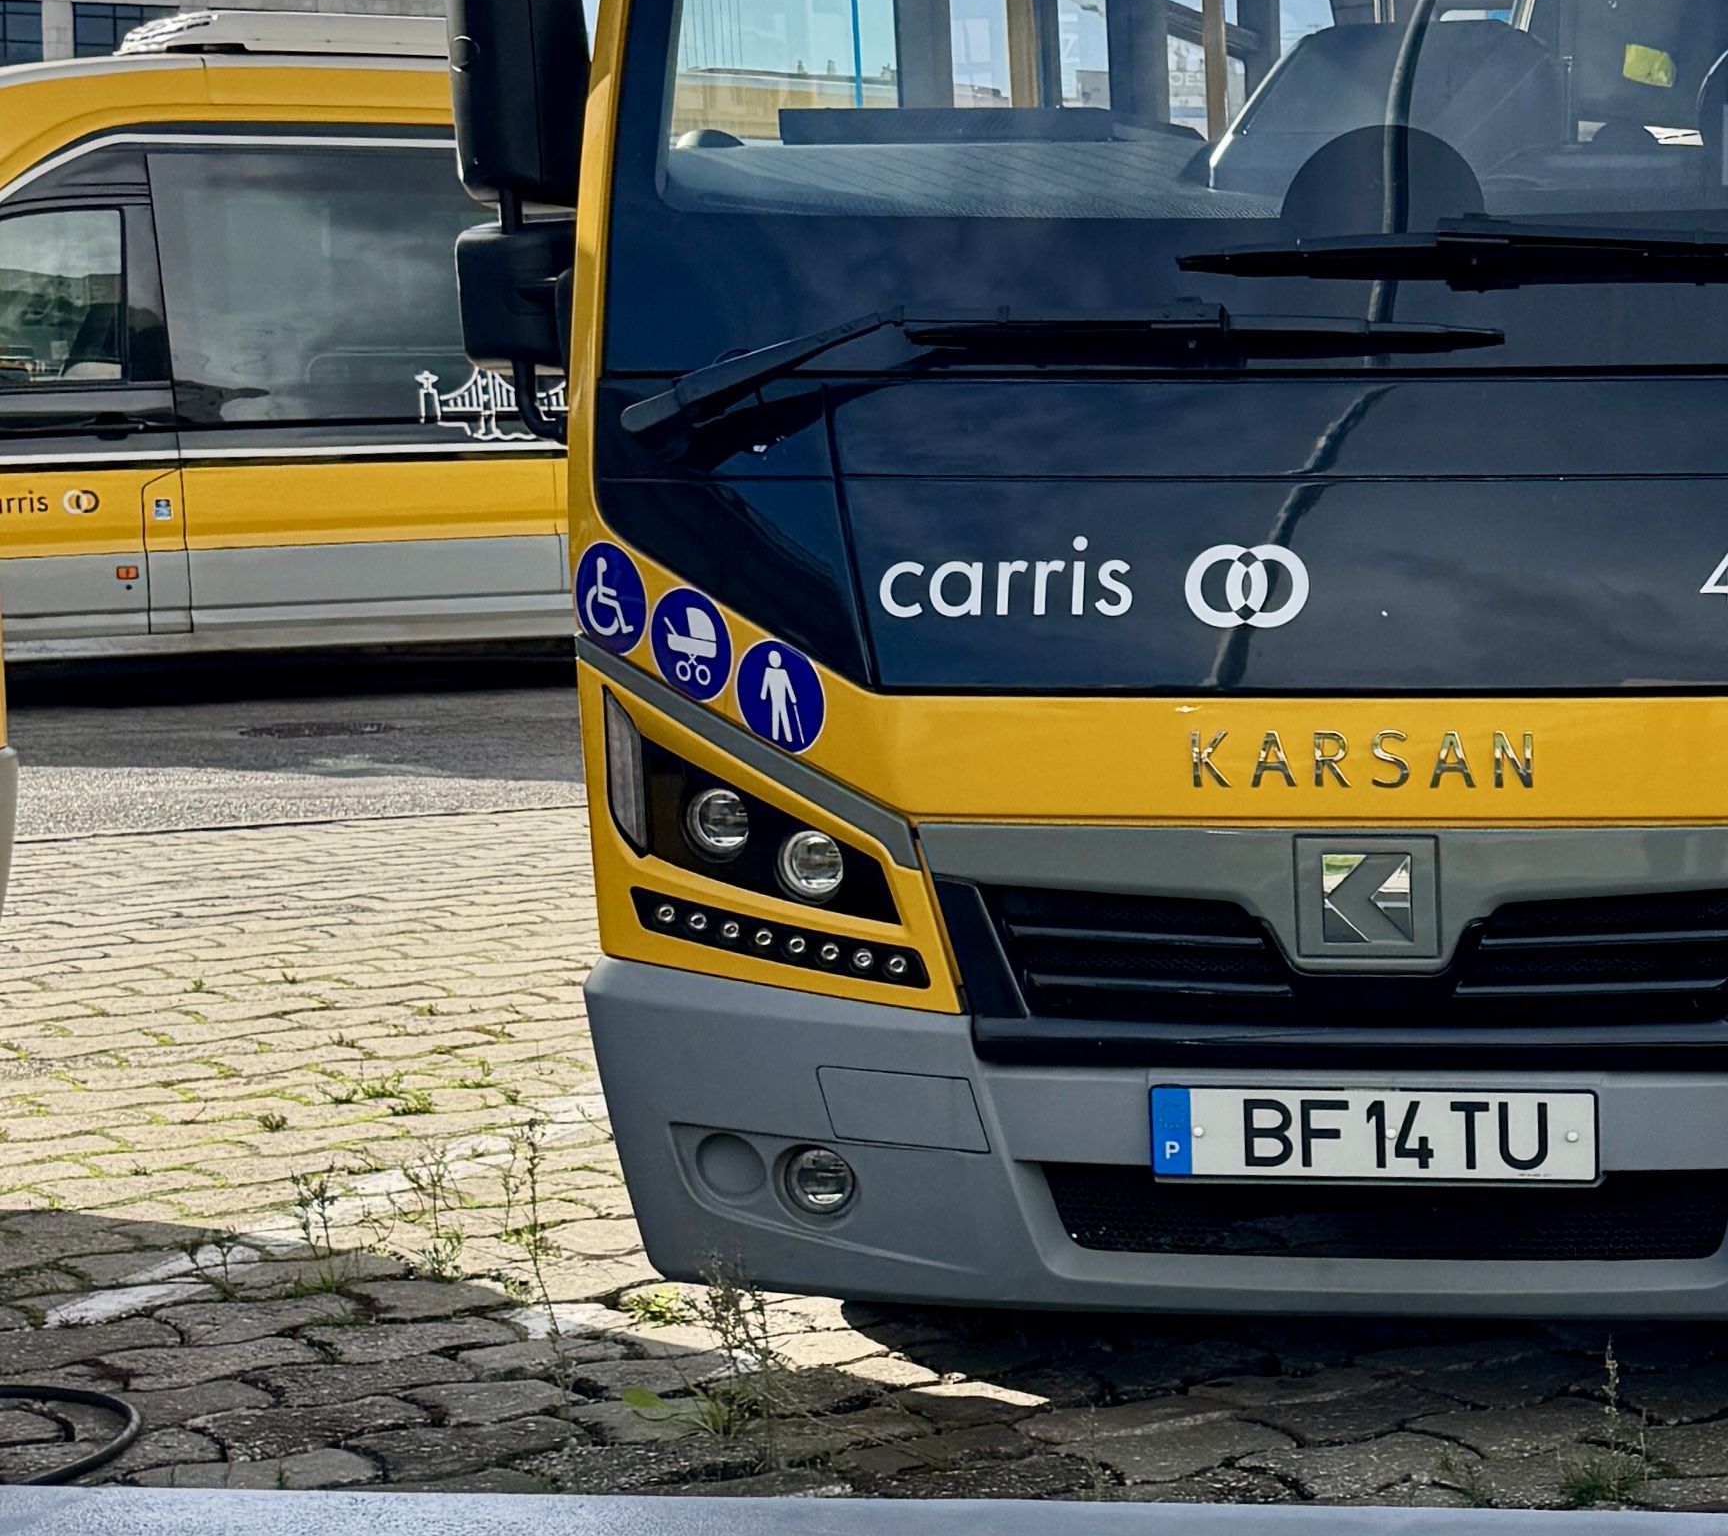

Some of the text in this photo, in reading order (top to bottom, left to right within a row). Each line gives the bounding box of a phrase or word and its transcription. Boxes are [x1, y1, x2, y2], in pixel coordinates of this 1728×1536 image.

[0, 489, 49, 514] rris
[879, 535, 1133, 618] carris
[1191, 729, 1535, 789] KARSAN
[1165, 1098, 1548, 1171] P BF 14 TU
